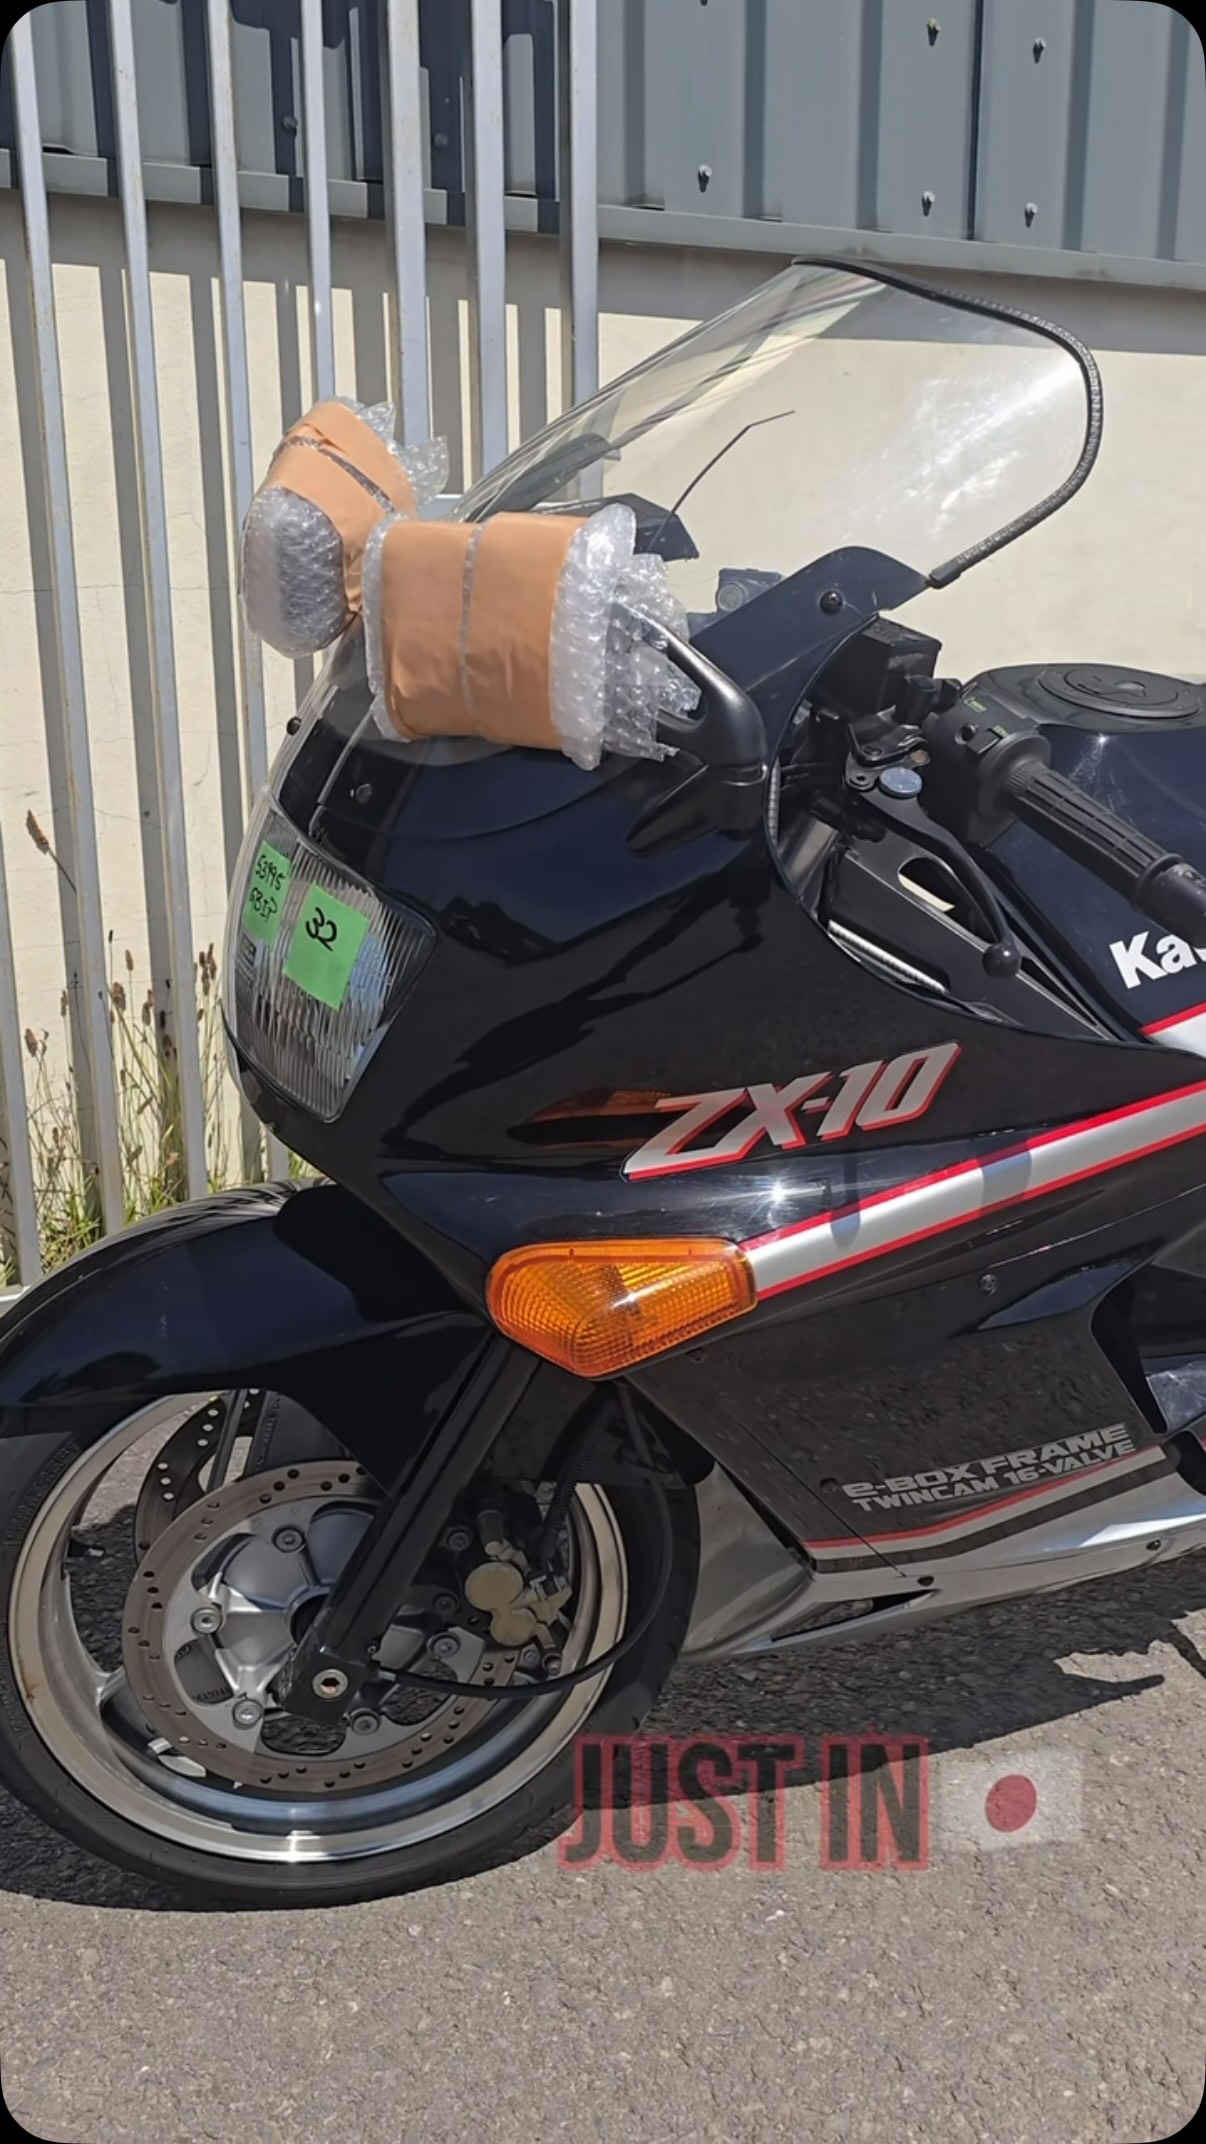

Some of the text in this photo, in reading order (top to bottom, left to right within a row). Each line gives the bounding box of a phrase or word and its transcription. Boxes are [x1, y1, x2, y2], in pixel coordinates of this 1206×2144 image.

[305, 906, 338, 952] 32
[1108, 930, 1206, 989] Ka
[623, 1041, 963, 1181] ZX-10
[851, 1438, 1137, 1513] TWINCAM 16-VALVE
[977, 1422, 1130, 1475] FRAME
